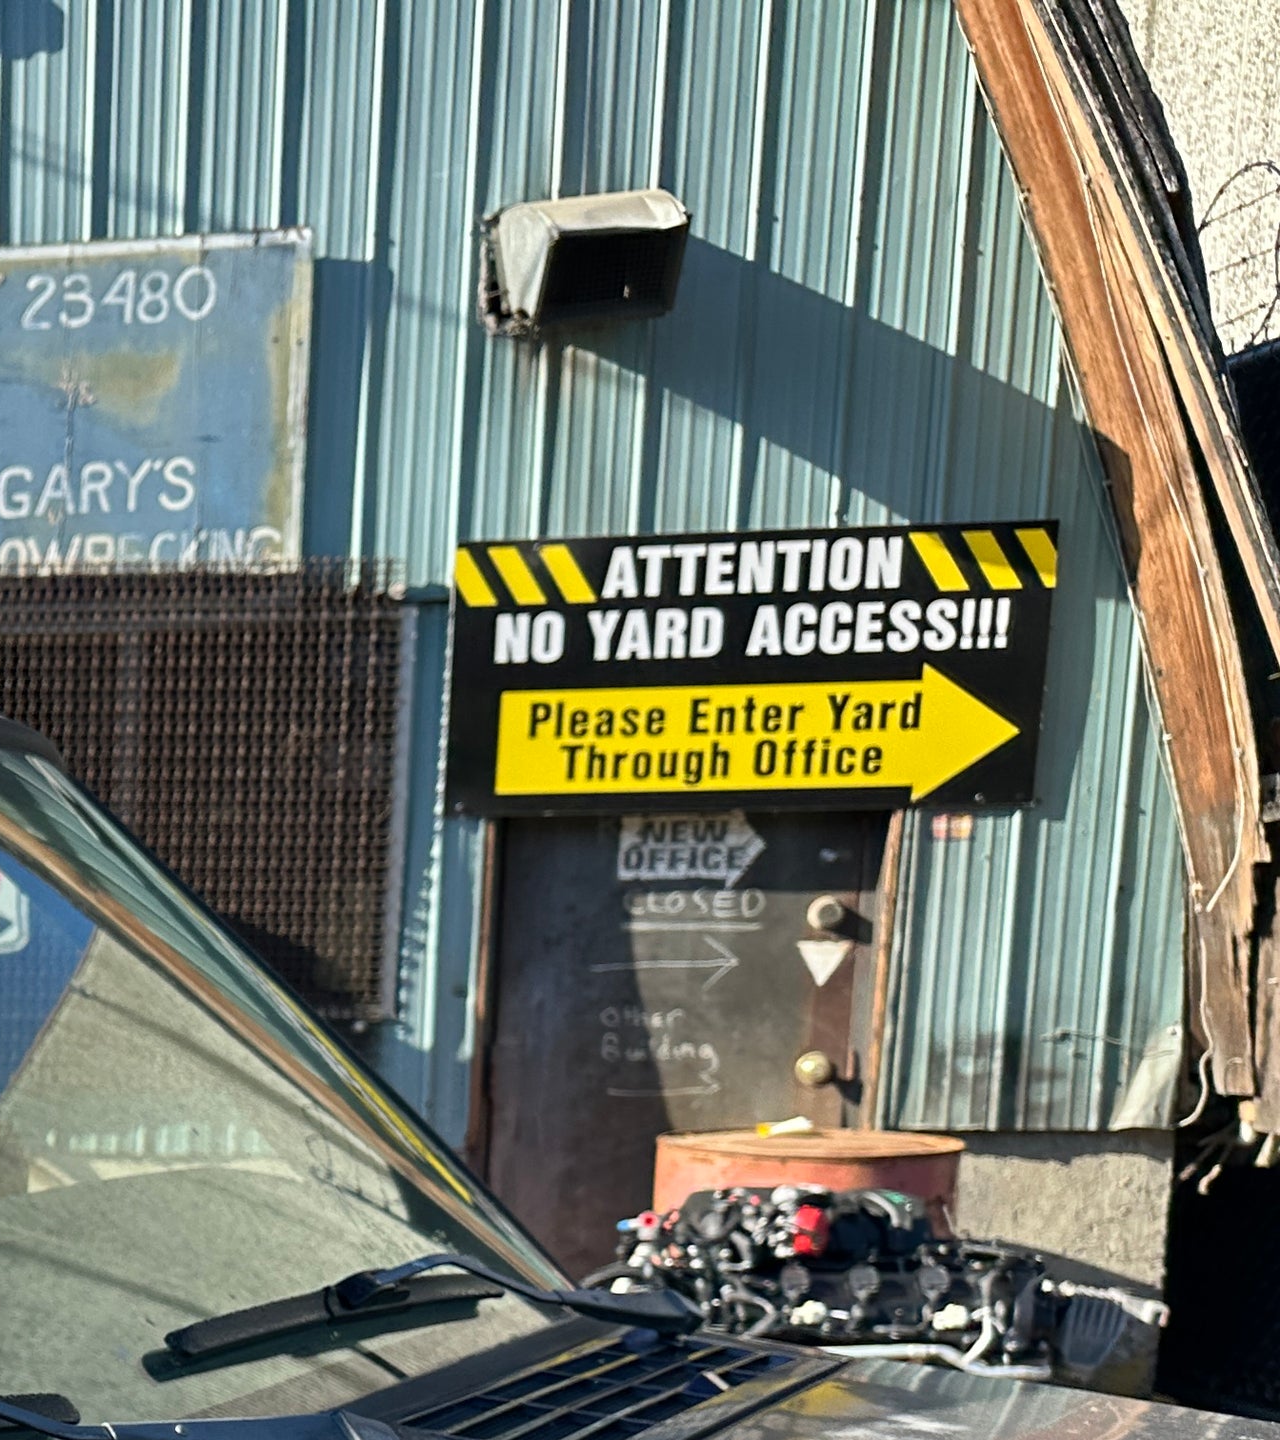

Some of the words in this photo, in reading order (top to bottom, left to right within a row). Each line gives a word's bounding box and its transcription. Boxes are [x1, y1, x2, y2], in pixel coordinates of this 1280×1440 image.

[20, 265, 218, 331] 23480
[601, 535, 904, 600] ATTENTION
[494, 611, 565, 664] NO
[588, 606, 724, 661] YARD
[746, 596, 1011, 657] ACCESS!!!
[528, 702, 666, 739] Please
[688, 697, 805, 736] Enter
[828, 690, 923, 732] Yard
[559, 742, 731, 786] Through
[752, 739, 884, 777] Office
[638, 819, 730, 843] NEW
[623, 845, 743, 871] OFFICE
